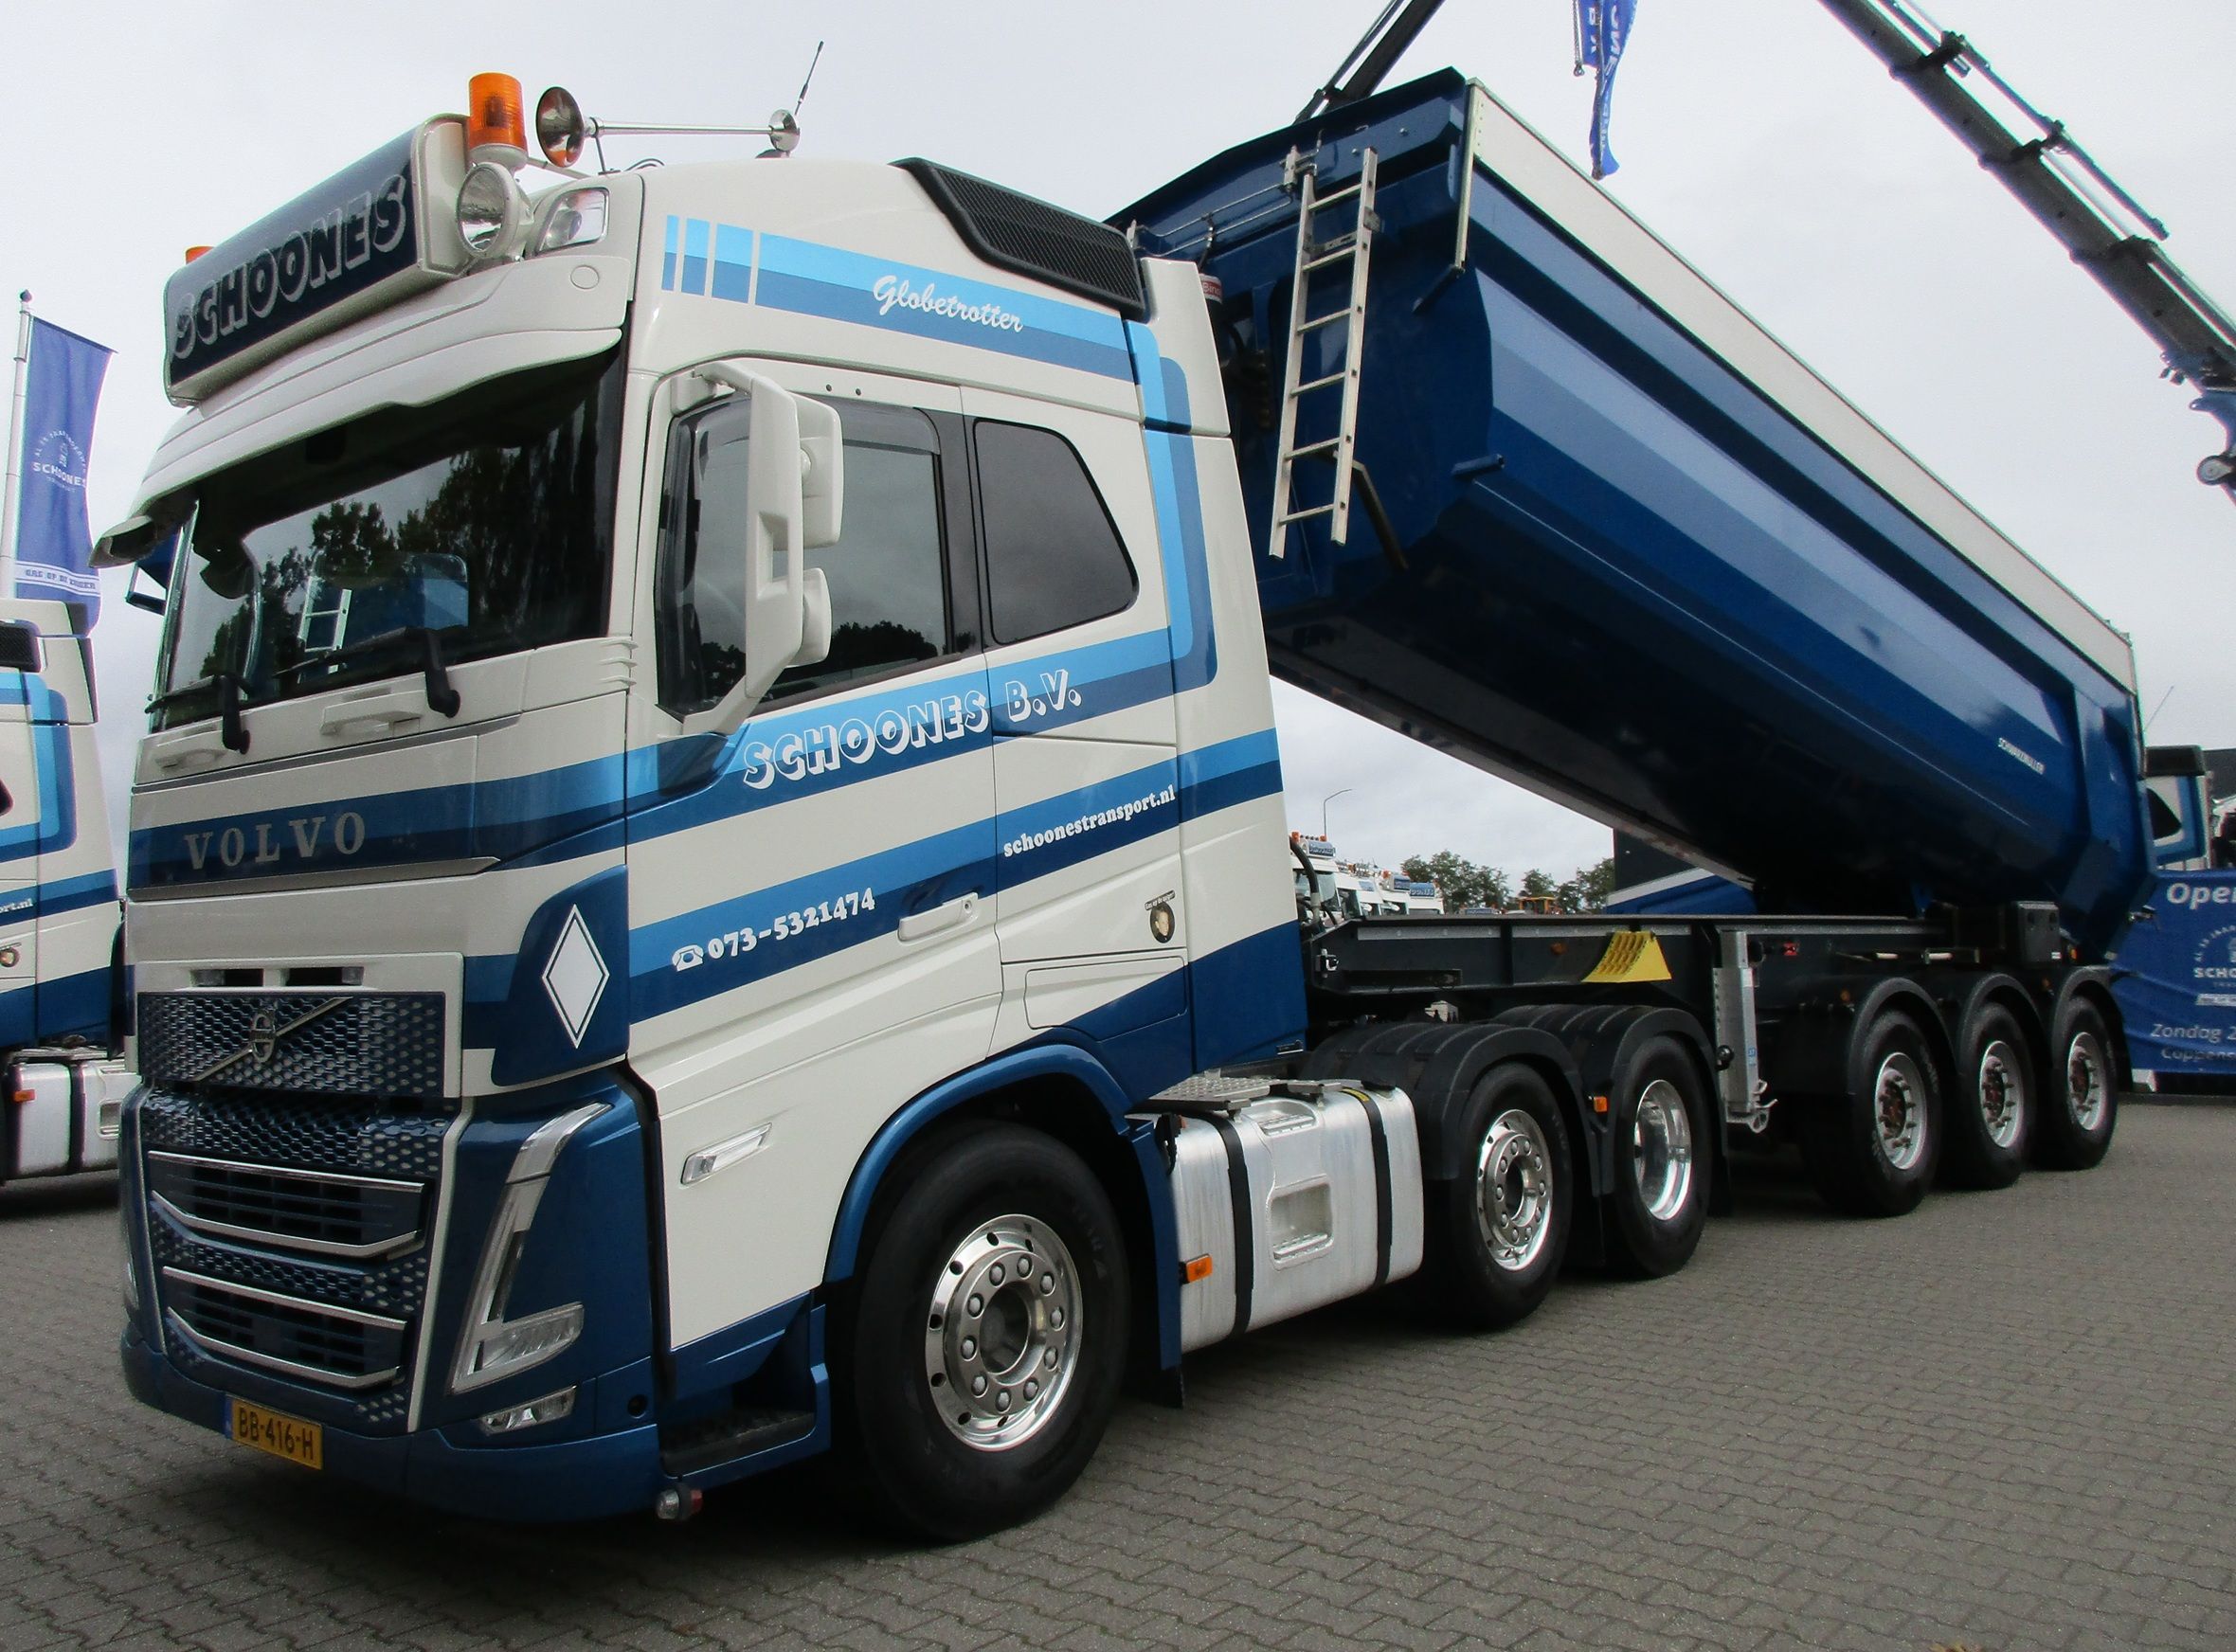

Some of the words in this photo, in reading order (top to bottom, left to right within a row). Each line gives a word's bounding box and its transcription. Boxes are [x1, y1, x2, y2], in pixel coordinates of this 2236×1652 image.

[173, 173, 406, 360] SCHOONES
[873, 275, 1023, 332] Globetrotter
[743, 690, 989, 789] SCHOONES
[1005, 669, 1082, 723] B.V.
[183, 812, 366, 871] VOLVO
[1003, 784, 1177, 857] schoonestransport.nl
[708, 888, 875, 960] 073-5321474
[2151, 1024, 2222, 1044] Zondag
[239, 1407, 314, 1460] BB-416-H
